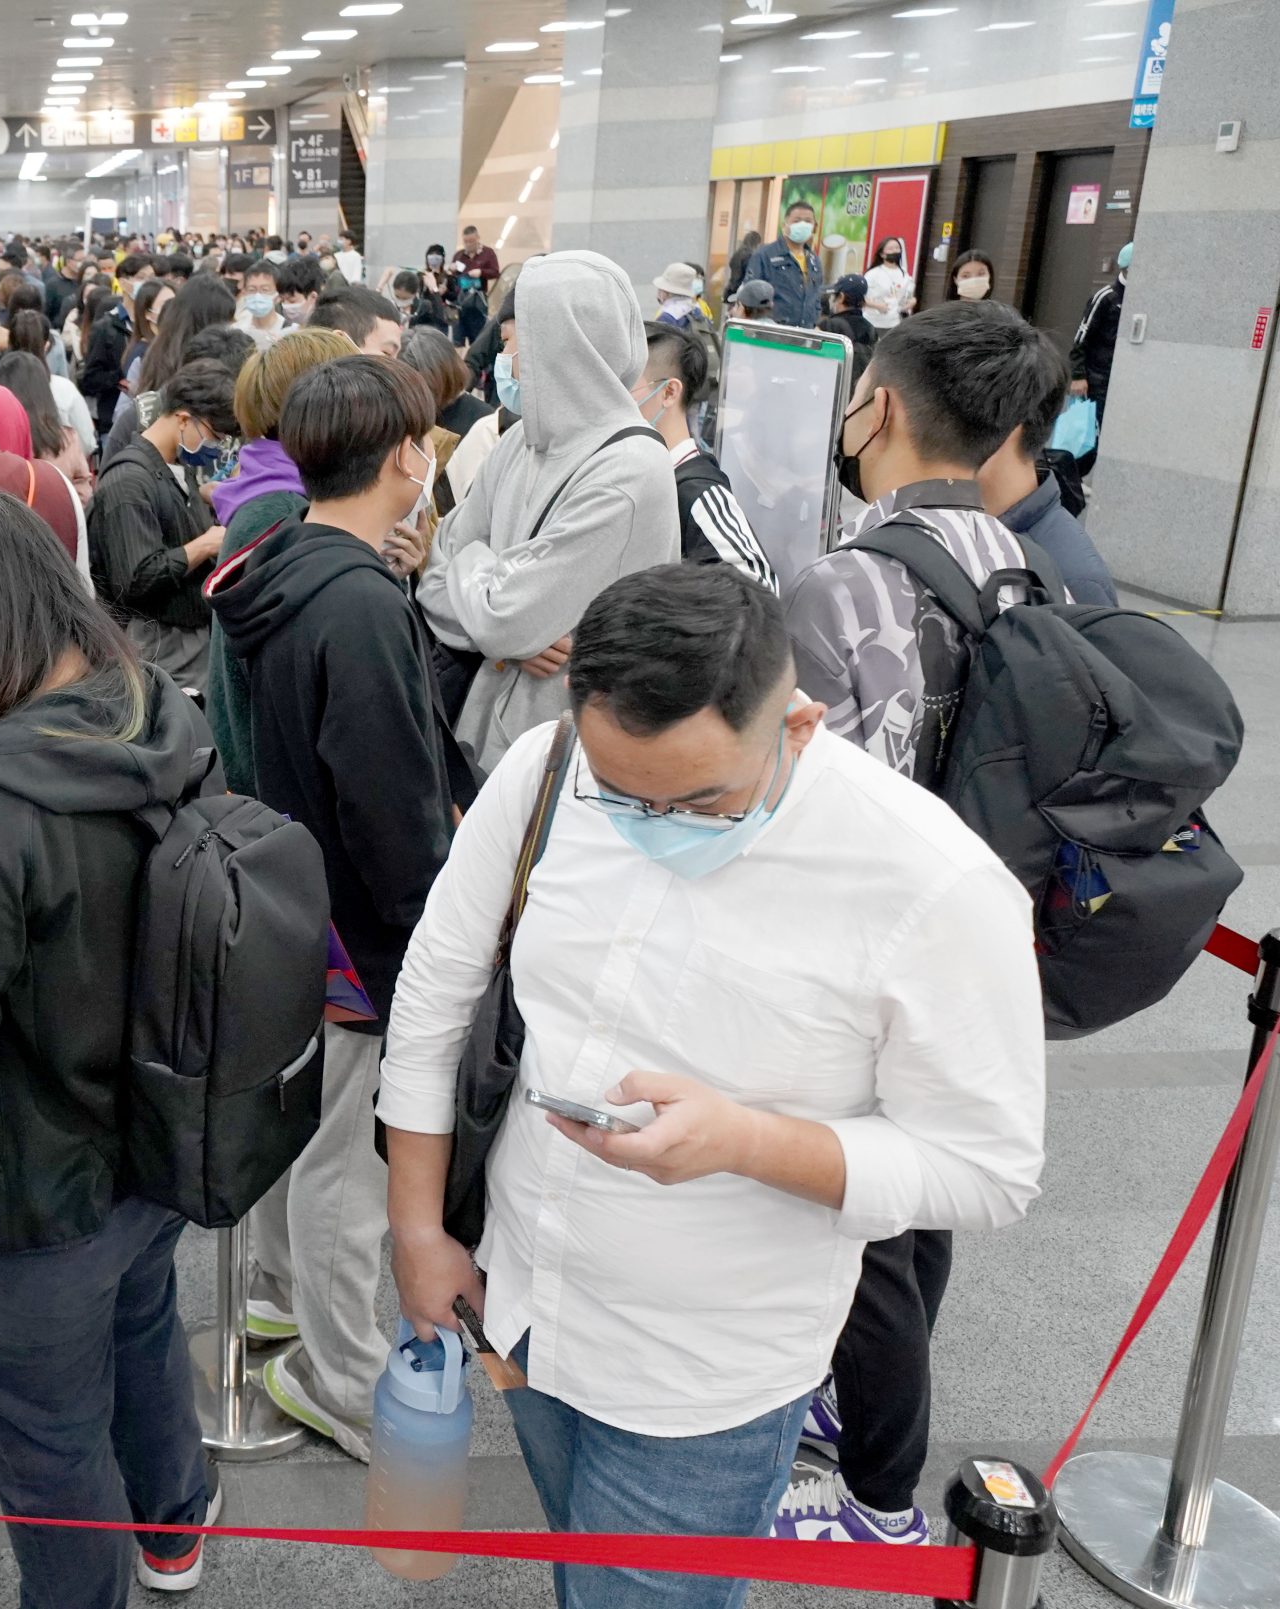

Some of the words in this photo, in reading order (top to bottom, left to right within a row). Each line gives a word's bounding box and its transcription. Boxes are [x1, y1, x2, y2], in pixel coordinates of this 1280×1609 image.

[308, 134, 324, 147] 4F
[233, 168, 252, 183] 1F
[847, 182, 871, 199] MOS
